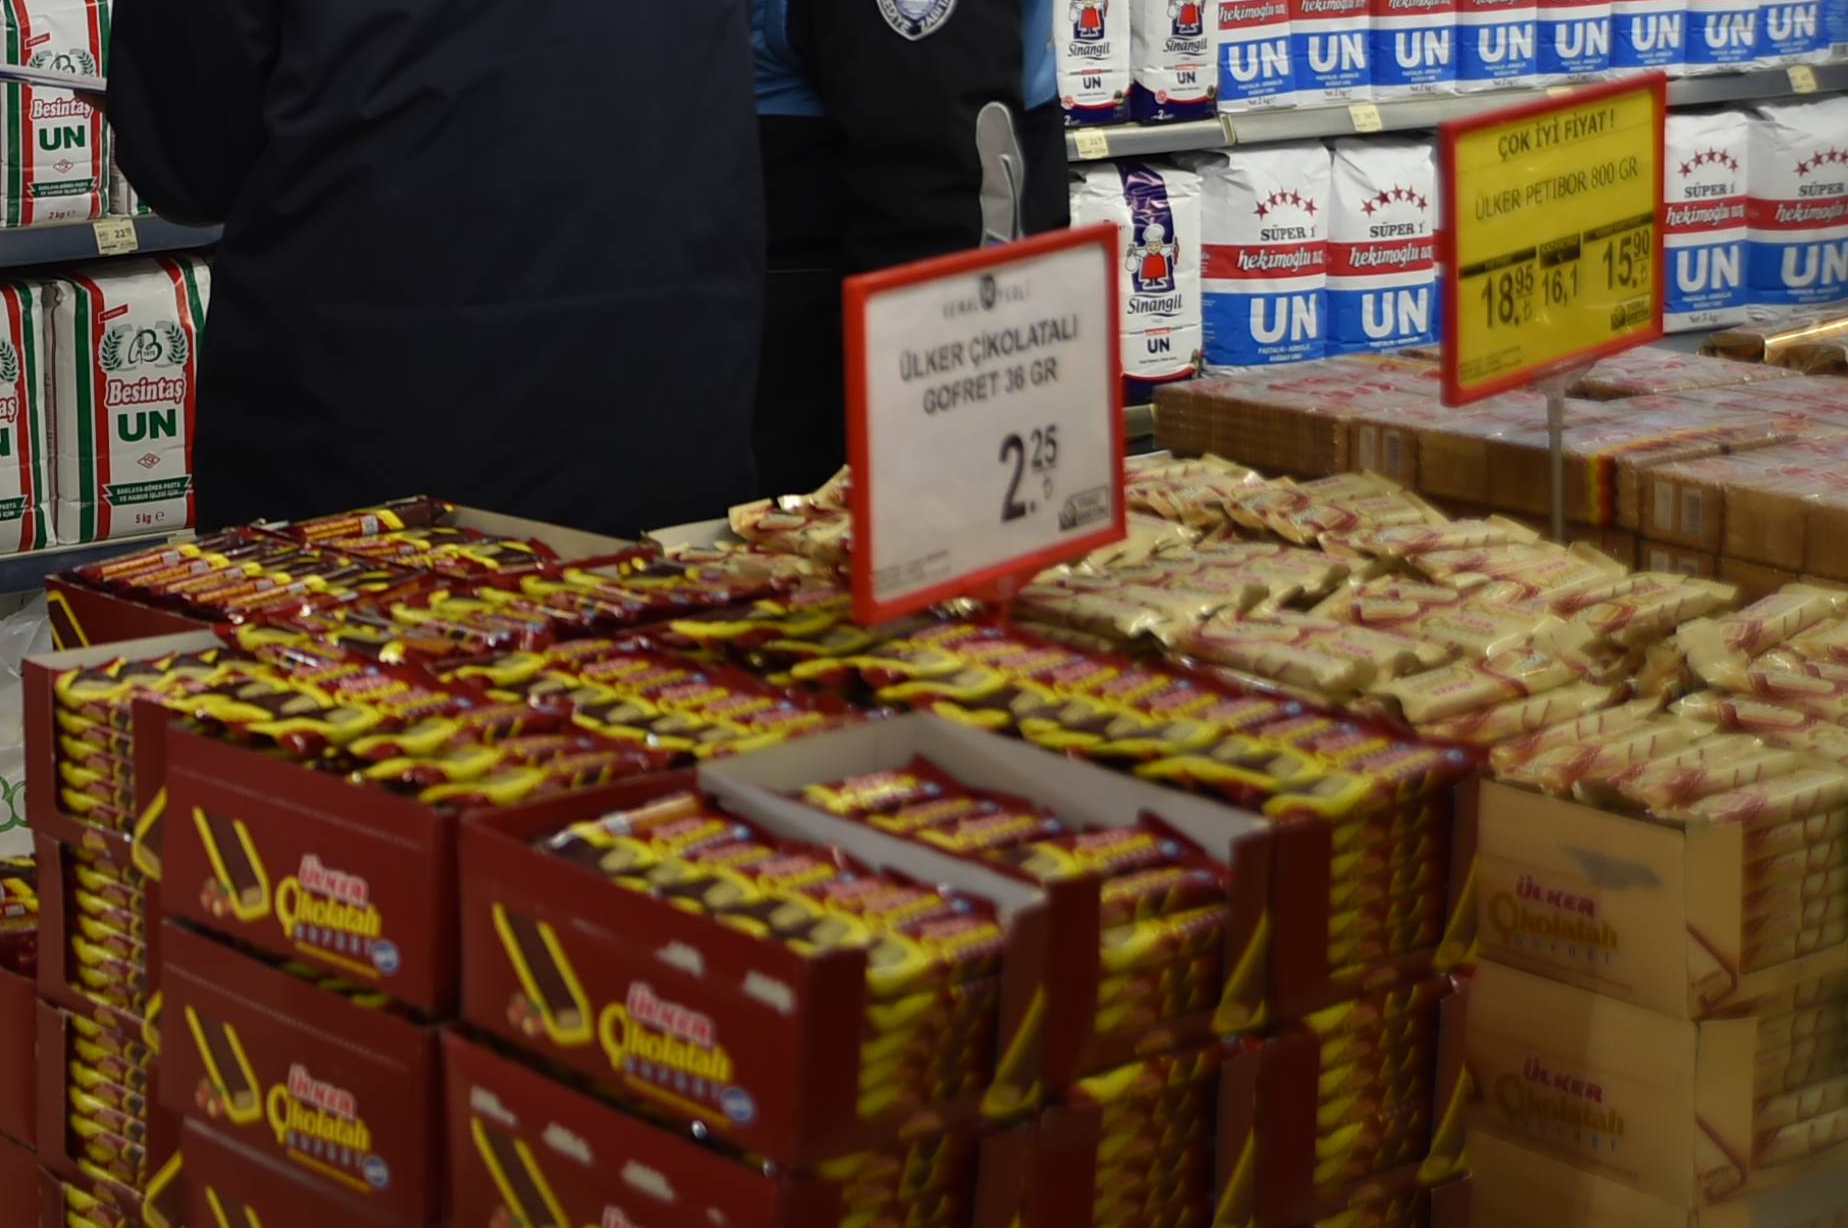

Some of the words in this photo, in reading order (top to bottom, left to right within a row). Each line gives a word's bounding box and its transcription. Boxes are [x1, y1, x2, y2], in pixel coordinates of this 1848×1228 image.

[1068, 41, 1110, 57] Sinangil
[1228, 39, 1290, 82] UN
[1395, 29, 1449, 68] UN
[1083, 72, 1101, 89] UN
[1498, 130, 1531, 161] ÇOK
[1535, 119, 1559, 148] İYİ
[1564, 111, 1606, 141] FİYAT
[1475, 188, 1521, 221] ÜLKER
[1590, 162, 1615, 189] 800
[1619, 156, 1638, 180] GR
[1260, 223, 1306, 241] SÜPER
[1541, 263, 1578, 306] 16,1
[1676, 245, 1740, 293] UN
[1127, 294, 1183, 315] Sinangil
[1250, 293, 1319, 344] UN
[899, 343, 964, 383] ÜLKER
[968, 315, 1079, 369] ÇİKOLATALI
[1147, 337, 1171, 353] UN
[105, 376, 185, 406] Besintaş
[923, 370, 999, 416] GOFRET
[1005, 367, 1025, 395] 36
[1030, 357, 1058, 387] GR
[117, 408, 177, 442] UN
[1515, 874, 1597, 919] ÜLKER
